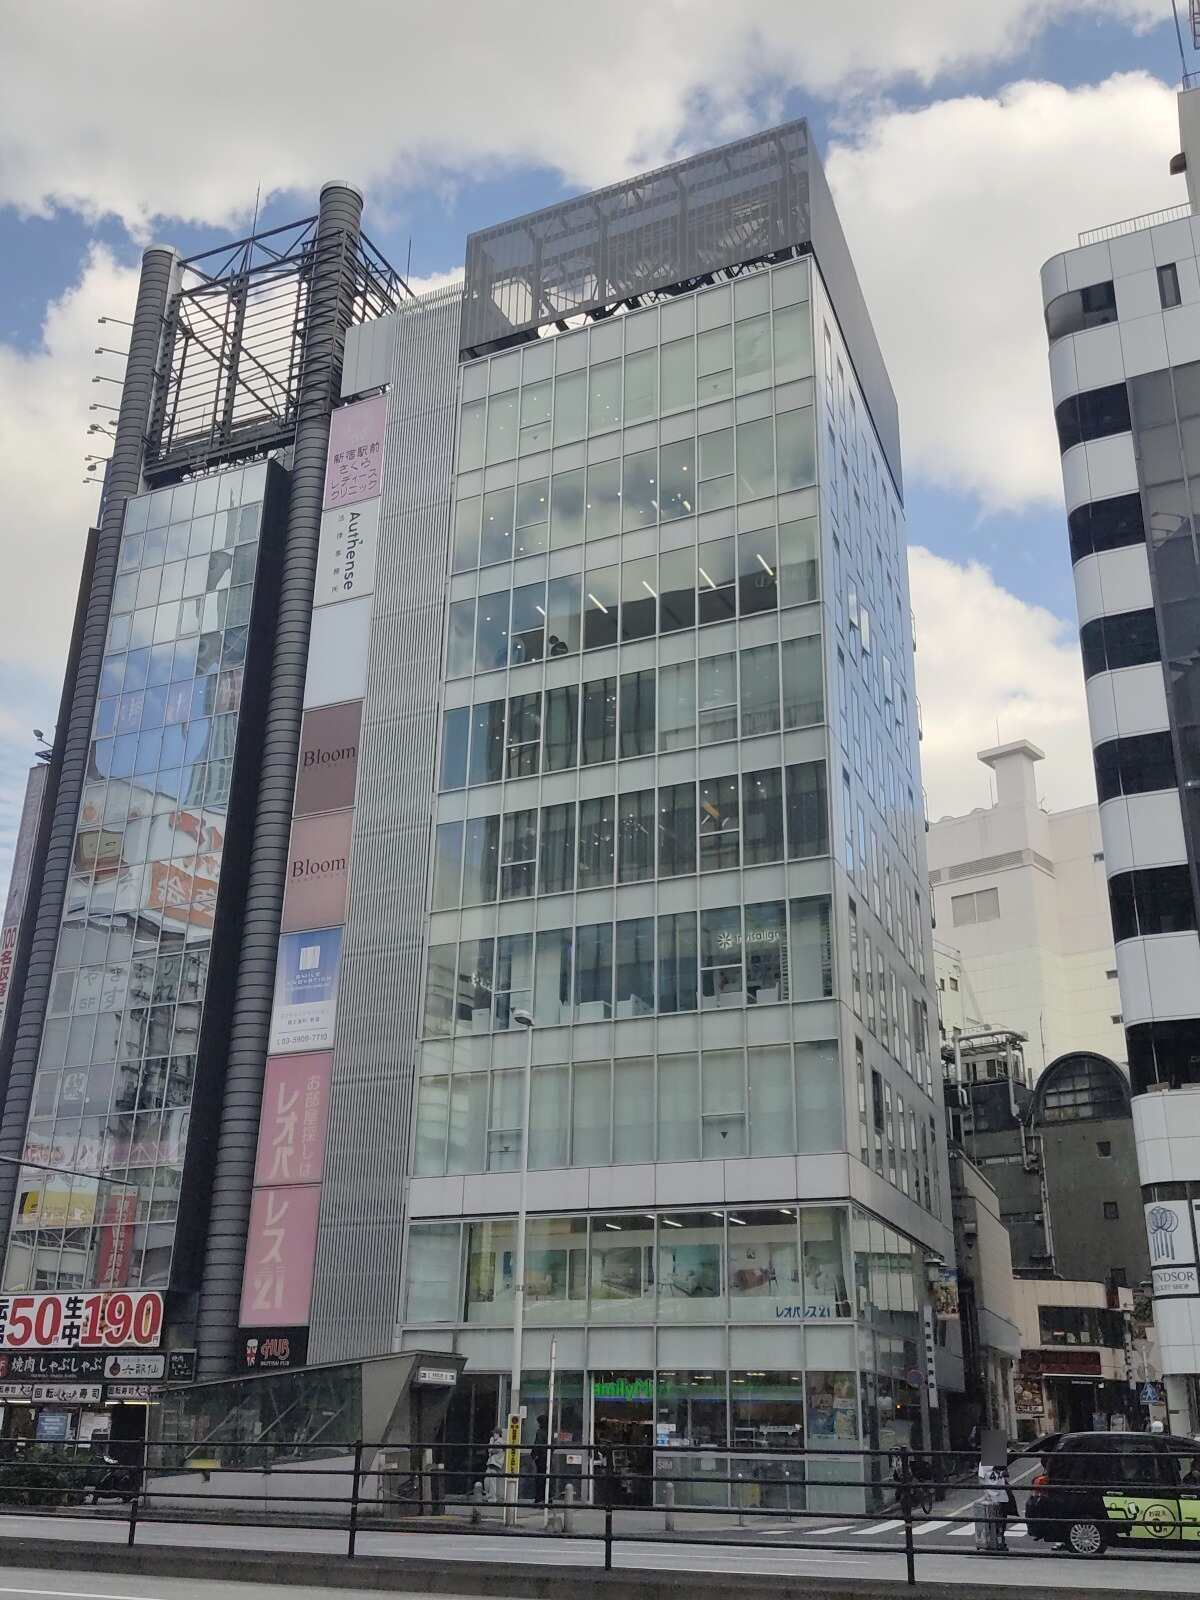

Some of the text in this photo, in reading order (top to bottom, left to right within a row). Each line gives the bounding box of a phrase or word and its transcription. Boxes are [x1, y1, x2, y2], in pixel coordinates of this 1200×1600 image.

[333, 441, 380, 465] 新宿駅前
[343, 512, 363, 591] Authense
[303, 746, 357, 767] Bloom
[291, 858, 346, 878] Bloom
[61, 1295, 84, 1346] 生中
[260, 1338, 290, 1361] HUB
[11, 1356, 103, 1374] 焼肉しゃぶしゃぶ
